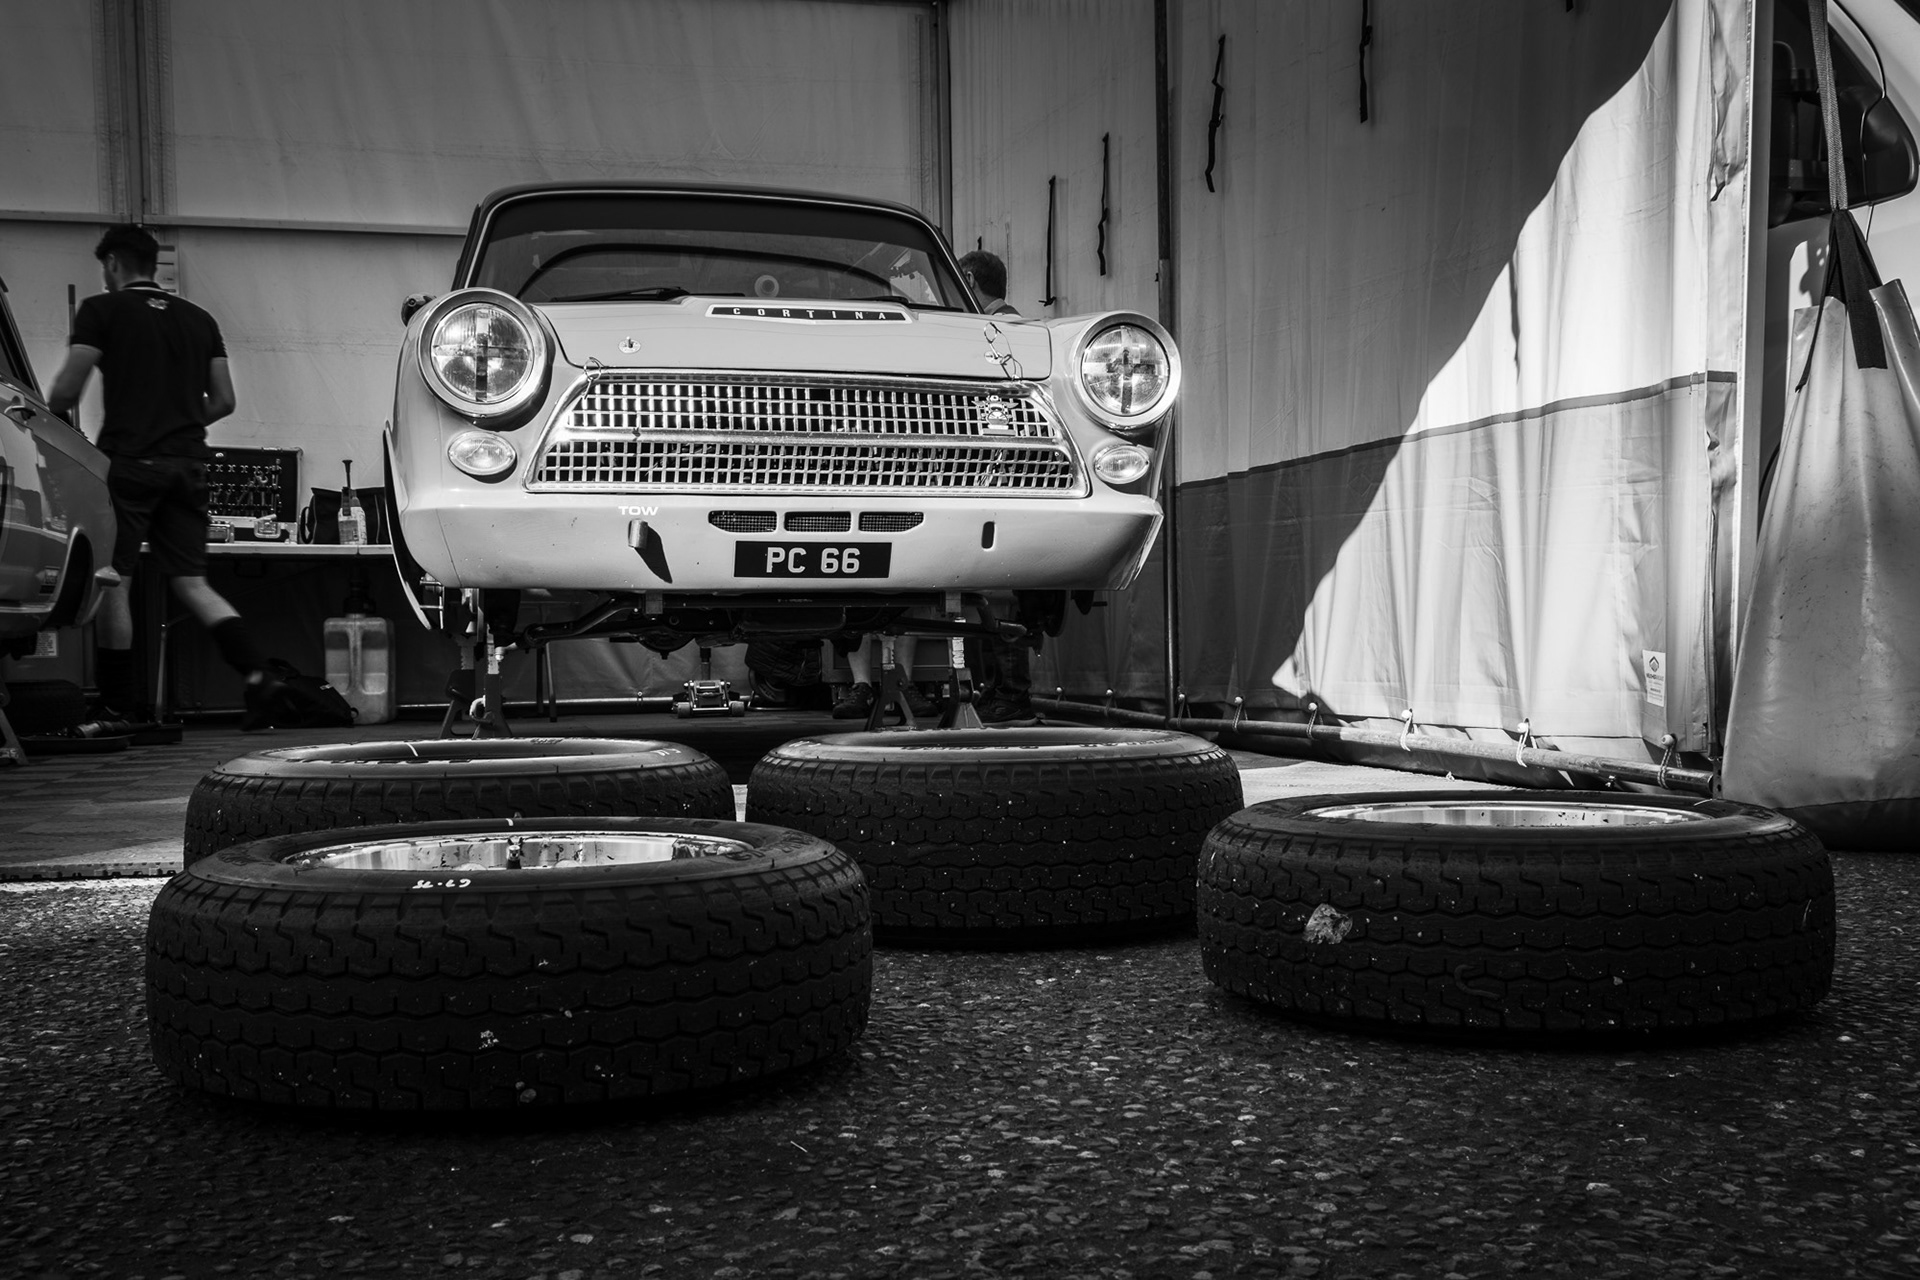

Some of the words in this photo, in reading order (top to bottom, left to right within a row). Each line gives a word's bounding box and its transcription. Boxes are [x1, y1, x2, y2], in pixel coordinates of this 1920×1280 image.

[733, 307, 886, 320] CORTINA
[618, 505, 659, 516] TOW
[766, 546, 807, 574] PC
[820, 547, 861, 574] 66
